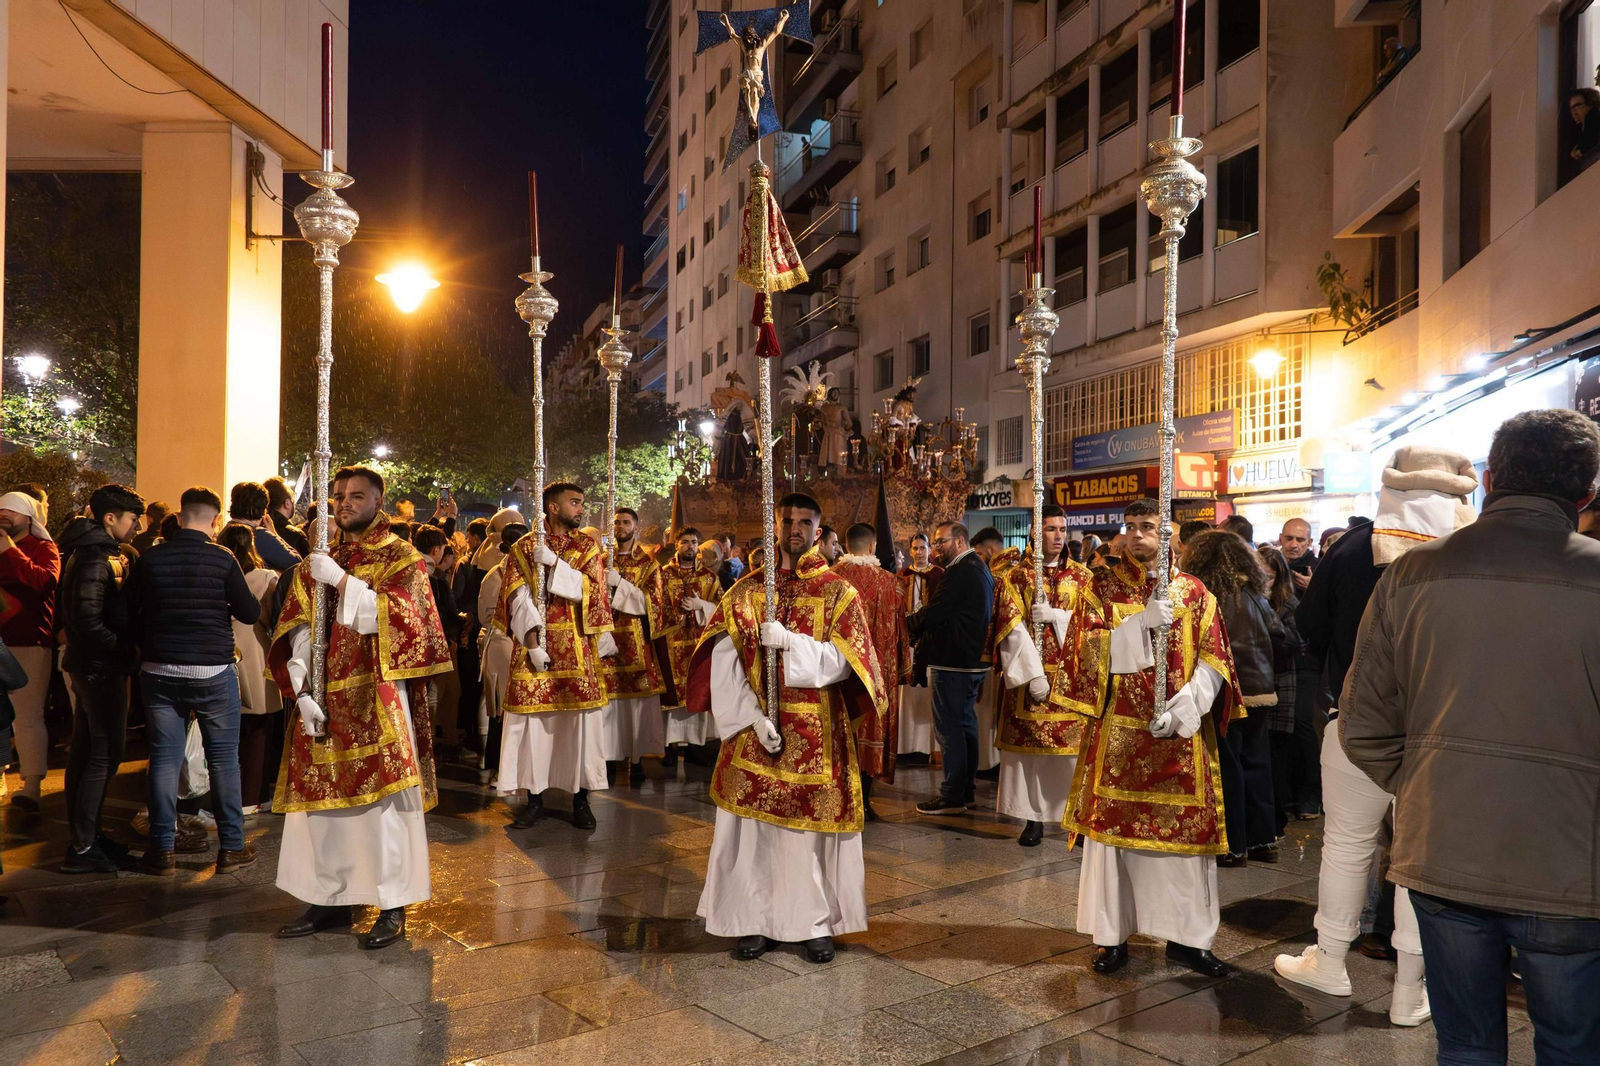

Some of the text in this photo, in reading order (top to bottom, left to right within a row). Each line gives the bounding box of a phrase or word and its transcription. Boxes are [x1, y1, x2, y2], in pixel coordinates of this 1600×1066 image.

[1203, 415, 1232, 426] Oficina virtual
[1245, 458, 1305, 483] HUELVA
[1073, 474, 1138, 498] TABACOS
[1178, 490, 1212, 498] ESTANCO
[1185, 507, 1215, 518] TABACOS
[1066, 514, 1094, 526] TANCO
[1095, 513, 1107, 525] EL
